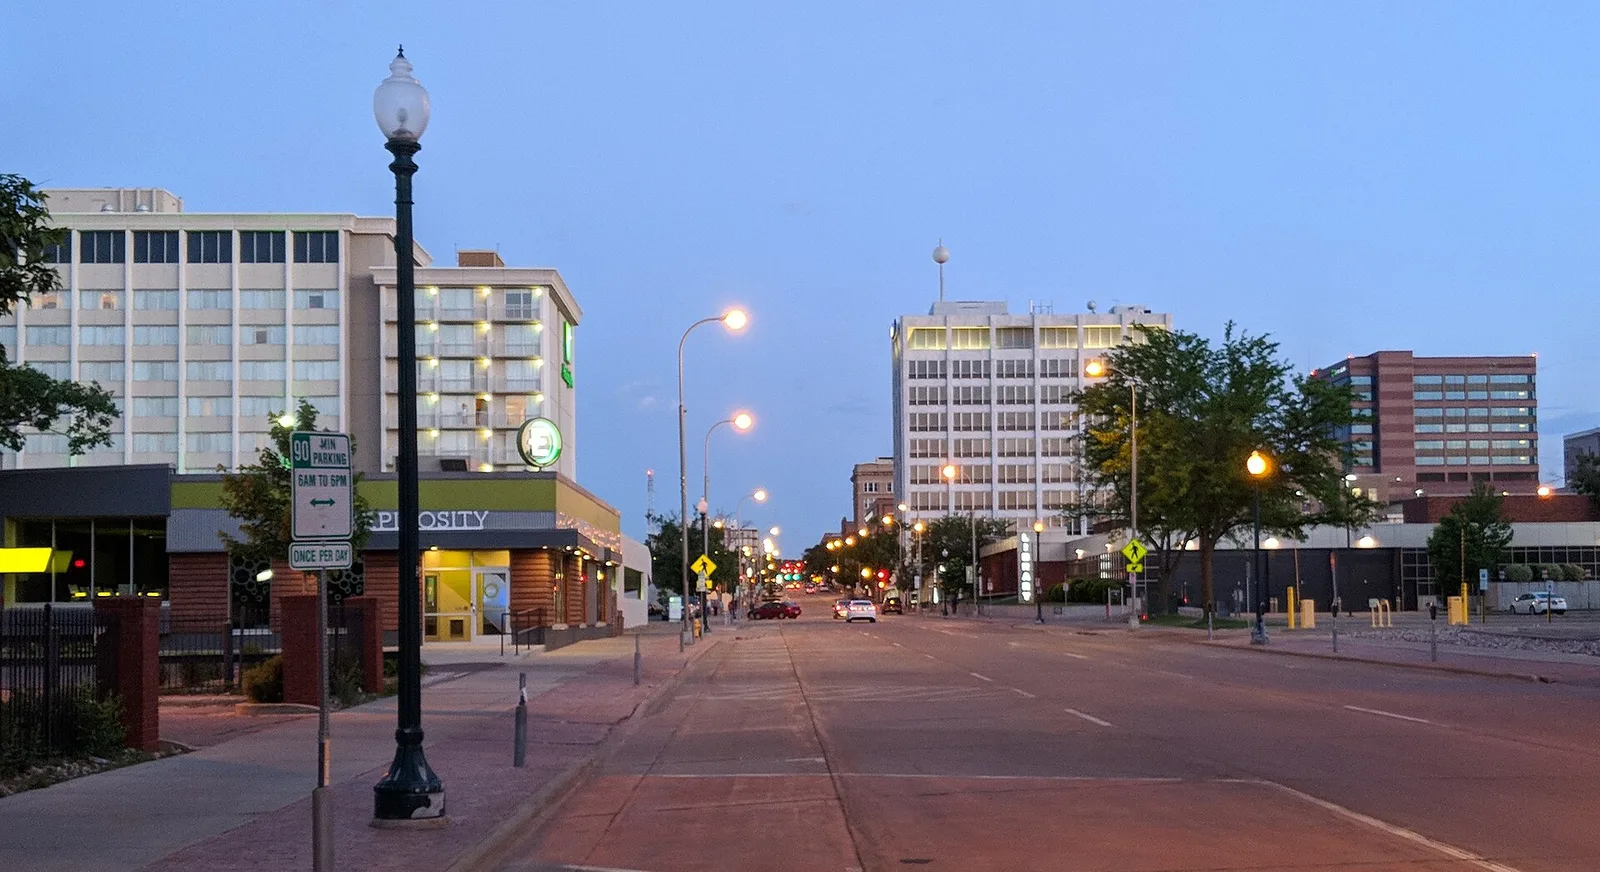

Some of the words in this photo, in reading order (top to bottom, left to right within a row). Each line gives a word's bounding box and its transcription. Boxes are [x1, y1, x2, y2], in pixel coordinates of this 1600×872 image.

[294, 440, 309, 461] 90
[319, 438, 336, 450] MIN
[313, 452, 347, 465] PARKING
[298, 474, 316, 487] 6AM
[318, 474, 328, 487] TO
[330, 475, 347, 487] 6PM
[363, 510, 489, 530] PIOSITY
[293, 550, 316, 562] ONCE
[319, 550, 333, 561] PER
[335, 550, 348, 561] DAY
